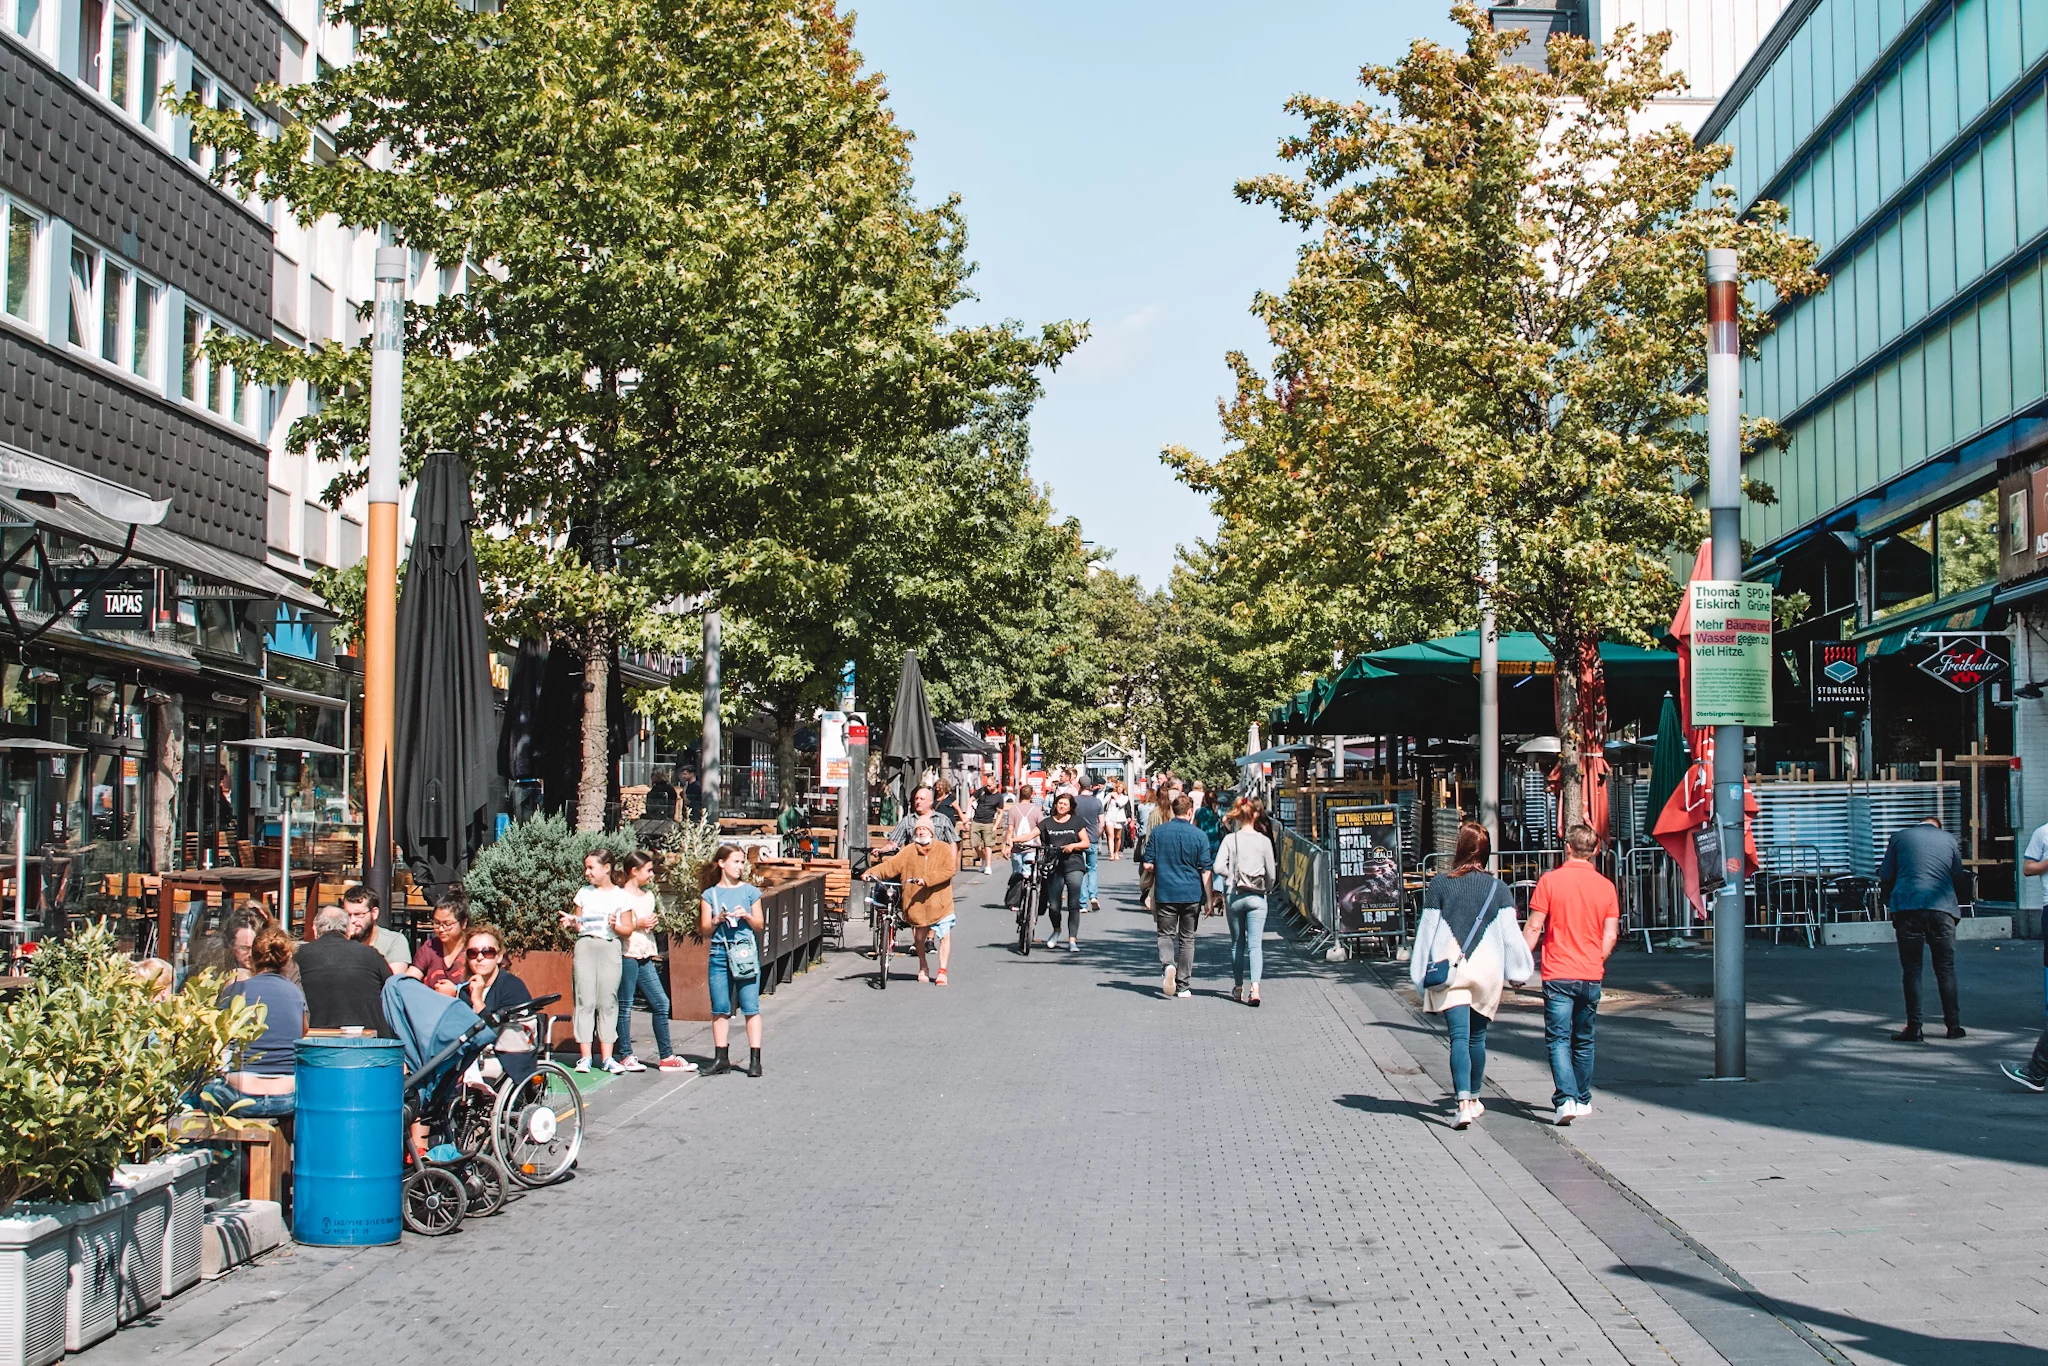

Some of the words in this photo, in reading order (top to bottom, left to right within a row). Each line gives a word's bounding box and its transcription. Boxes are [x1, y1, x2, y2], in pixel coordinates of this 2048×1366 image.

[1696, 587, 1740, 597] Thomas
[1747, 588, 1764, 598] SPD
[105, 594, 143, 613] TAPAS
[1696, 599, 1740, 610] Eiskirch
[1748, 600, 1770, 612] Grüne
[1696, 620, 1724, 630] Mehr
[1726, 619, 1756, 630] Bäume
[1758, 620, 1770, 632] und
[1696, 633, 1736, 643] Wasser
[1737, 634, 1760, 646] gegen
[1761, 636, 1768, 645] zu
[1696, 646, 1714, 656] viel
[1717, 646, 1744, 656] Hitze.
[1818, 686, 1865, 694] STONEGRILL
[1345, 813, 1364, 822] THREE
[1364, 812, 1382, 822] SIXTY
[1339, 835, 1372, 850] SPARE
[1340, 850, 1364, 862] RIBS
[1341, 862, 1365, 876] DEAL
[1363, 911, 1387, 924] 16,90
